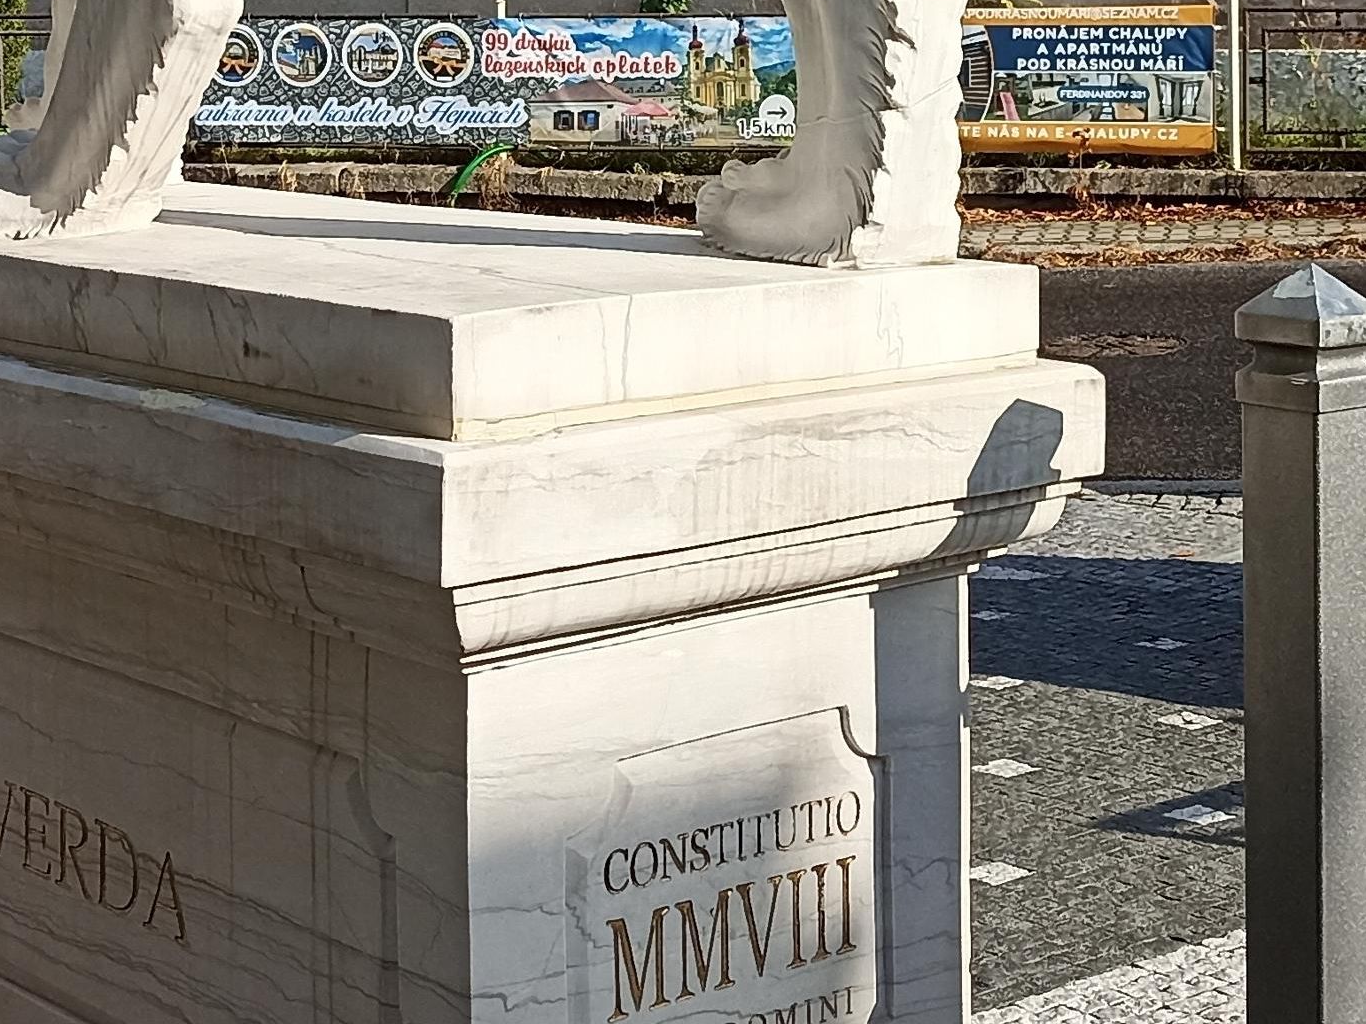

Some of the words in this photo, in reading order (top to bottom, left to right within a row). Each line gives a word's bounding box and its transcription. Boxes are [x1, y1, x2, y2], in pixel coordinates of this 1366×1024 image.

[485, 32, 508, 51] 99
[1012, 26, 1104, 40] PRONÁJEM
[1109, 28, 1188, 40] CHALUPY
[1036, 43, 1048, 55] A
[1054, 39, 1163, 56] APARTMÁNŮ
[593, 54, 677, 78] oplatek
[1017, 58, 1051, 71] POD
[1057, 55, 1135, 71] KRÁSNOU
[1140, 55, 1184, 71] MÁŘÍ
[1060, 89, 1129, 100] FERDINANDOV
[297, 109, 314, 122] u
[318, 100, 388, 122] kostela
[392, 109, 407, 122] v
[961, 127, 982, 138] TE
[987, 124, 1020, 138] NÁS
[1026, 127, 1049, 138] NA
[603, 790, 861, 895] CONSTITUTIO
[605, 854, 857, 1023] MMVIII
